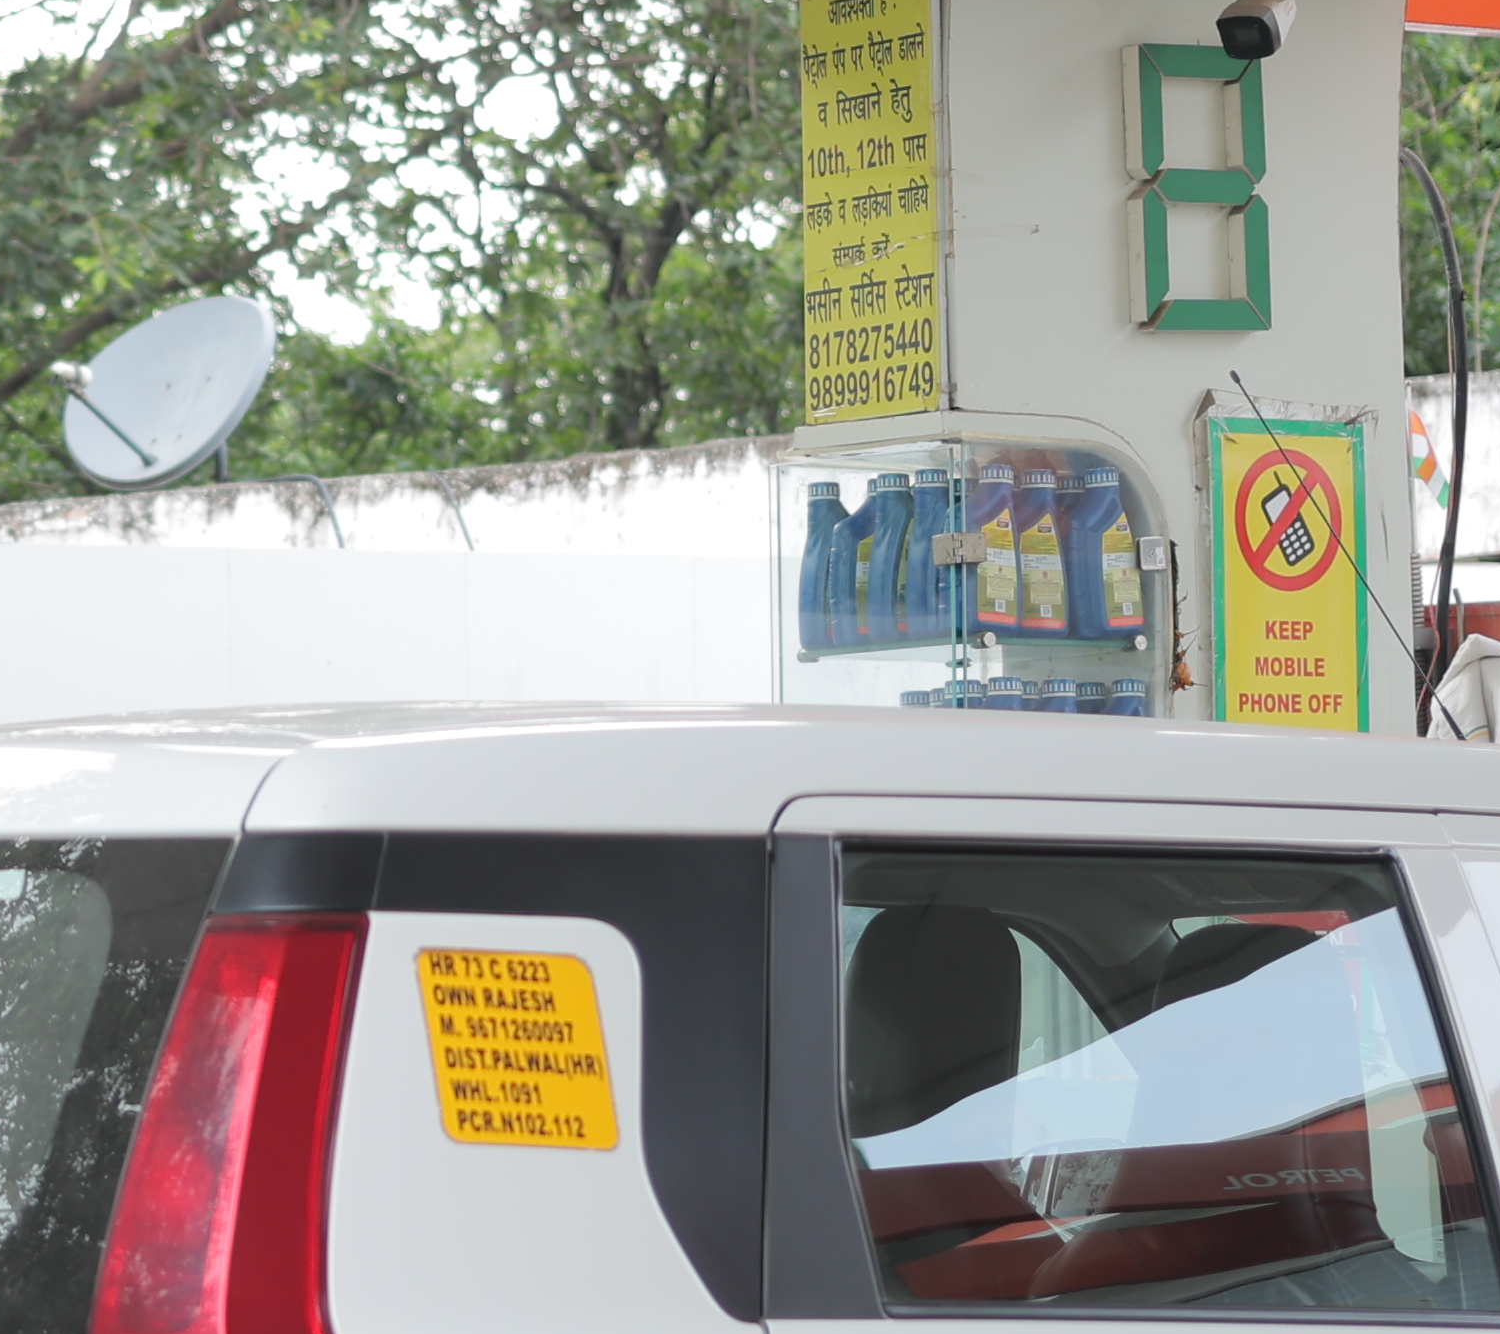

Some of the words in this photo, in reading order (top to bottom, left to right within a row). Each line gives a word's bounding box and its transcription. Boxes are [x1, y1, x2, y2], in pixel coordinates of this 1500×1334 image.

[832, 43, 846, 75] पंप
[851, 44, 864, 72] पर
[898, 22, 925, 61] डालने
[817, 101, 828, 128] व
[836, 82, 882, 126] सिखाने
[889, 79, 913, 123] हेतु
[807, 144, 850, 178] 10th,
[857, 135, 894, 169] 12th
[902, 133, 927, 163] पास
[806, 192, 833, 234] लड़के
[838, 198, 847, 225] व
[897, 174, 930, 216] चाहिये
[1136, 42, 1272, 331] 8
[806, 277, 842, 324] भसीन
[849, 268, 887, 318] सर्विस
[894, 264, 935, 311] स्टेशन
[809, 317, 934, 369] 8178275440
[810, 360, 934, 413] 9899916749
[1265, 620, 1314, 640] KEEP
[1255, 656, 1326, 677] MOBILE
[1239, 693, 1302, 713] PHONE
[1308, 694, 1343, 714] OFF
[428, 953, 457, 977] HR
[461, 956, 484, 979] 73
[489, 958, 501, 979] C
[506, 959, 551, 983] 6223
[433, 984, 476, 1007] OWN
[484, 987, 556, 1012] RAJESH
